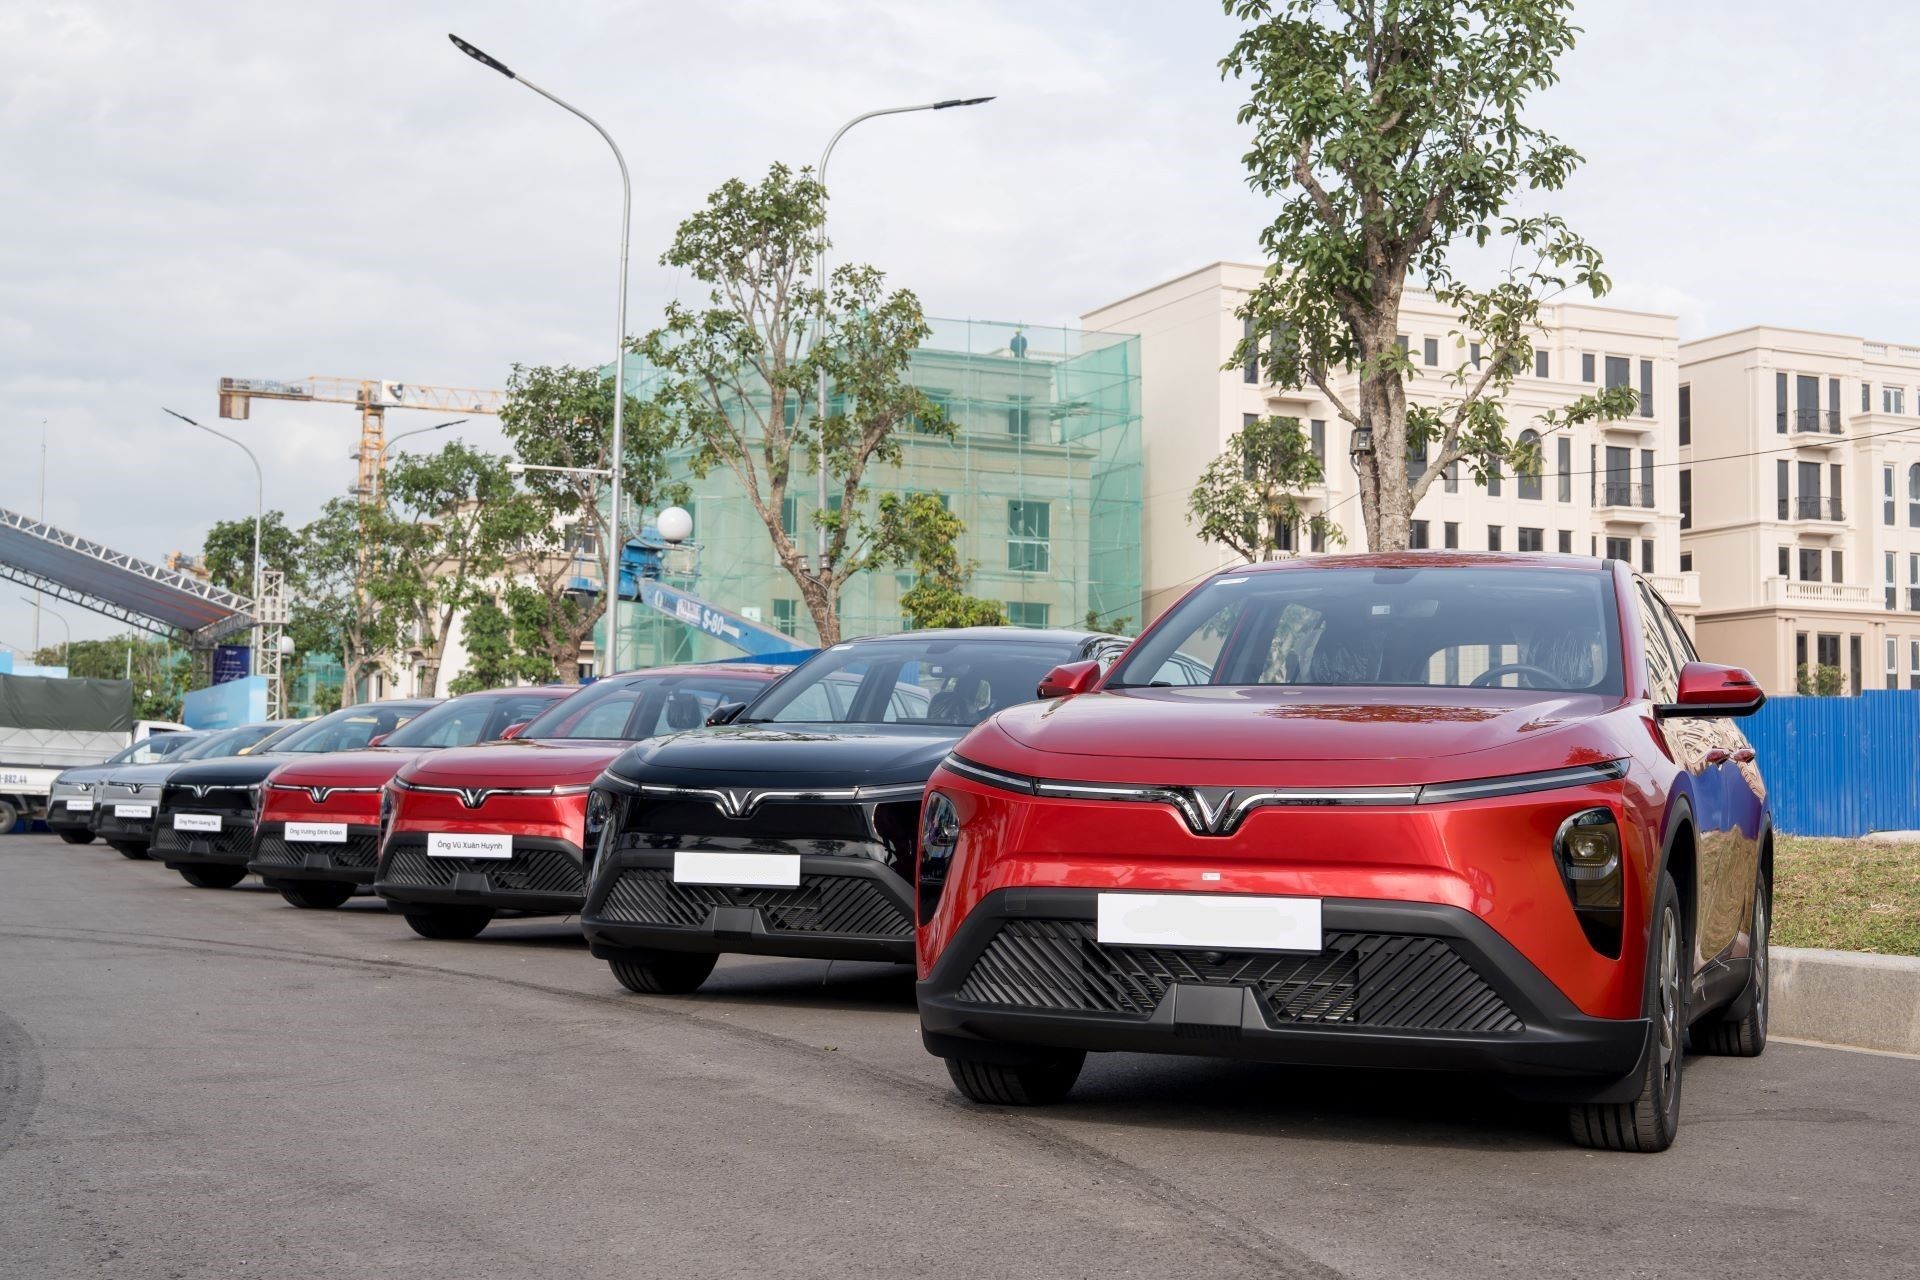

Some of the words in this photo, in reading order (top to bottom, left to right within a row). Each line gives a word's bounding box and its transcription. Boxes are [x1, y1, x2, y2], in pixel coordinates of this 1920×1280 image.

[702, 609, 723, 635] S-80
[437, 840, 451, 850] Ông
[463, 841, 480, 849] Xuân
